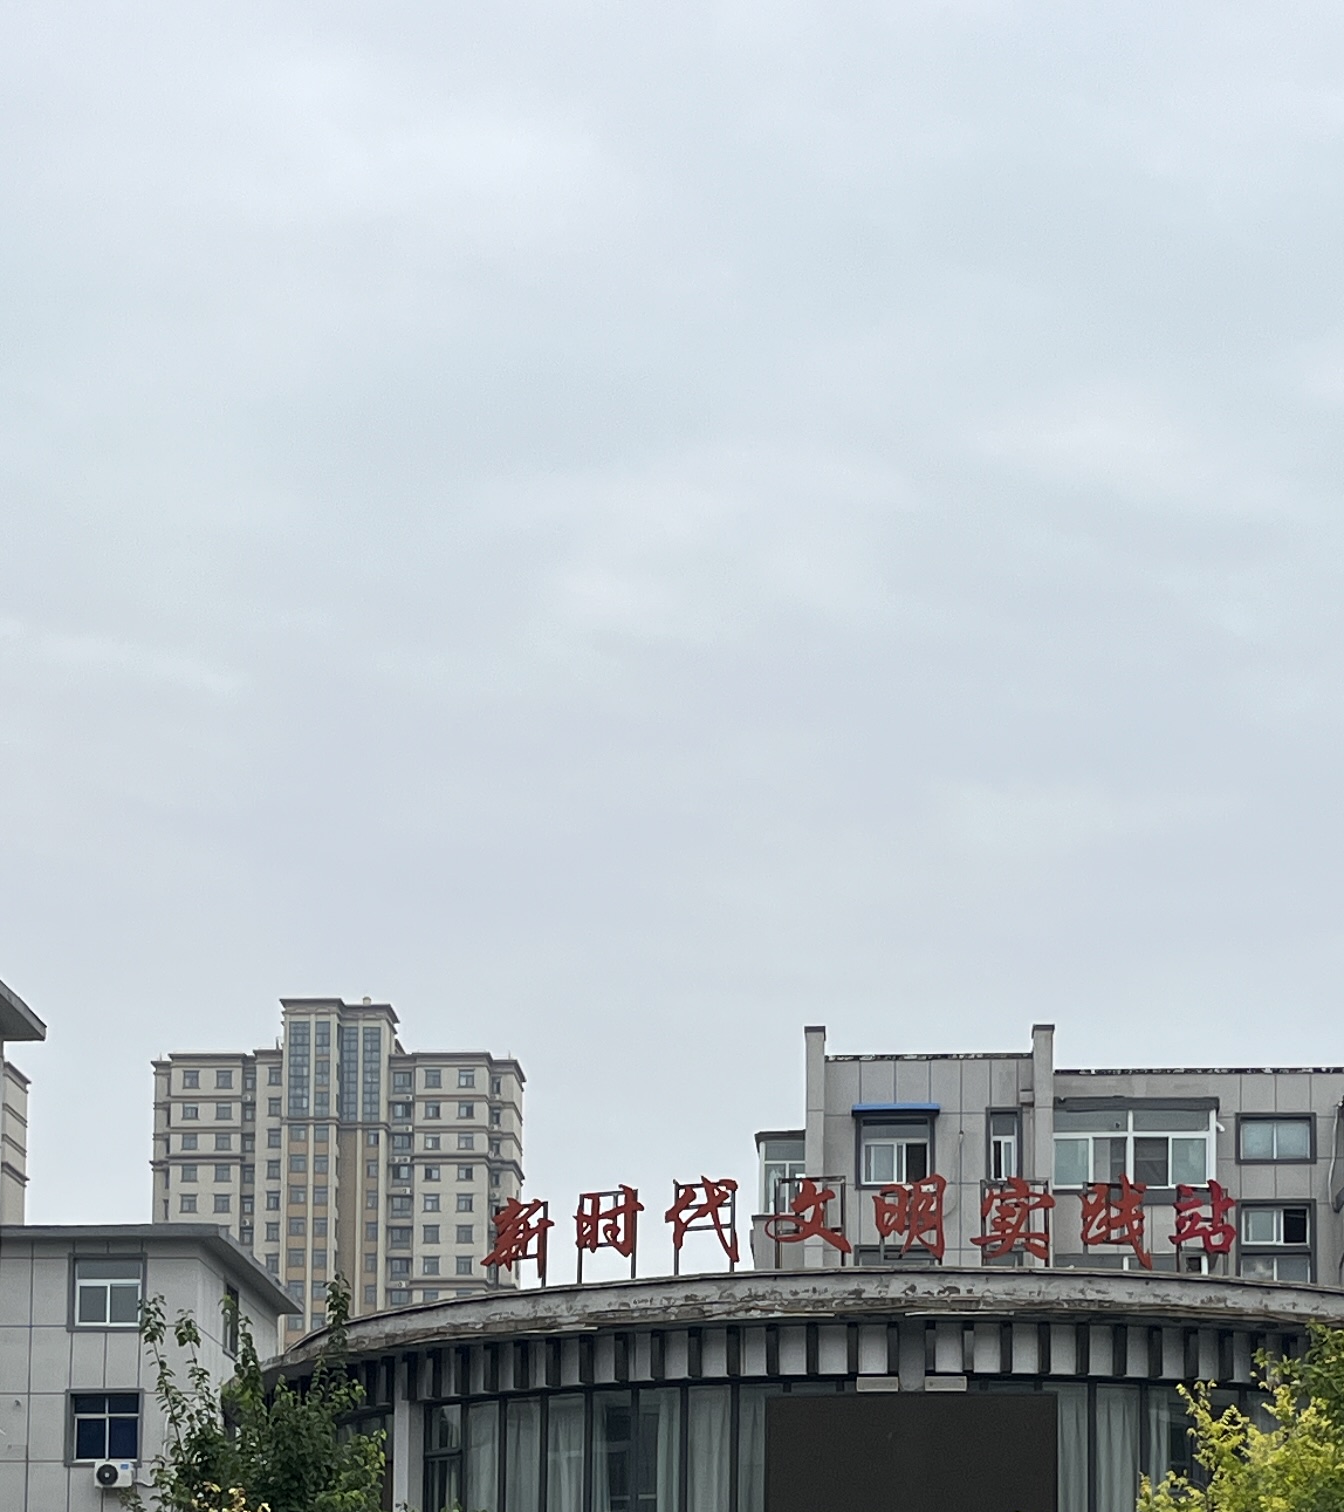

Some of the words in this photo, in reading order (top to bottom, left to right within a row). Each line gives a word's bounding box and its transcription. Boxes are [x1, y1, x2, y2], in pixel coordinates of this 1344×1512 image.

[481, 1174, 1236, 1277] 新时代文明实践站
